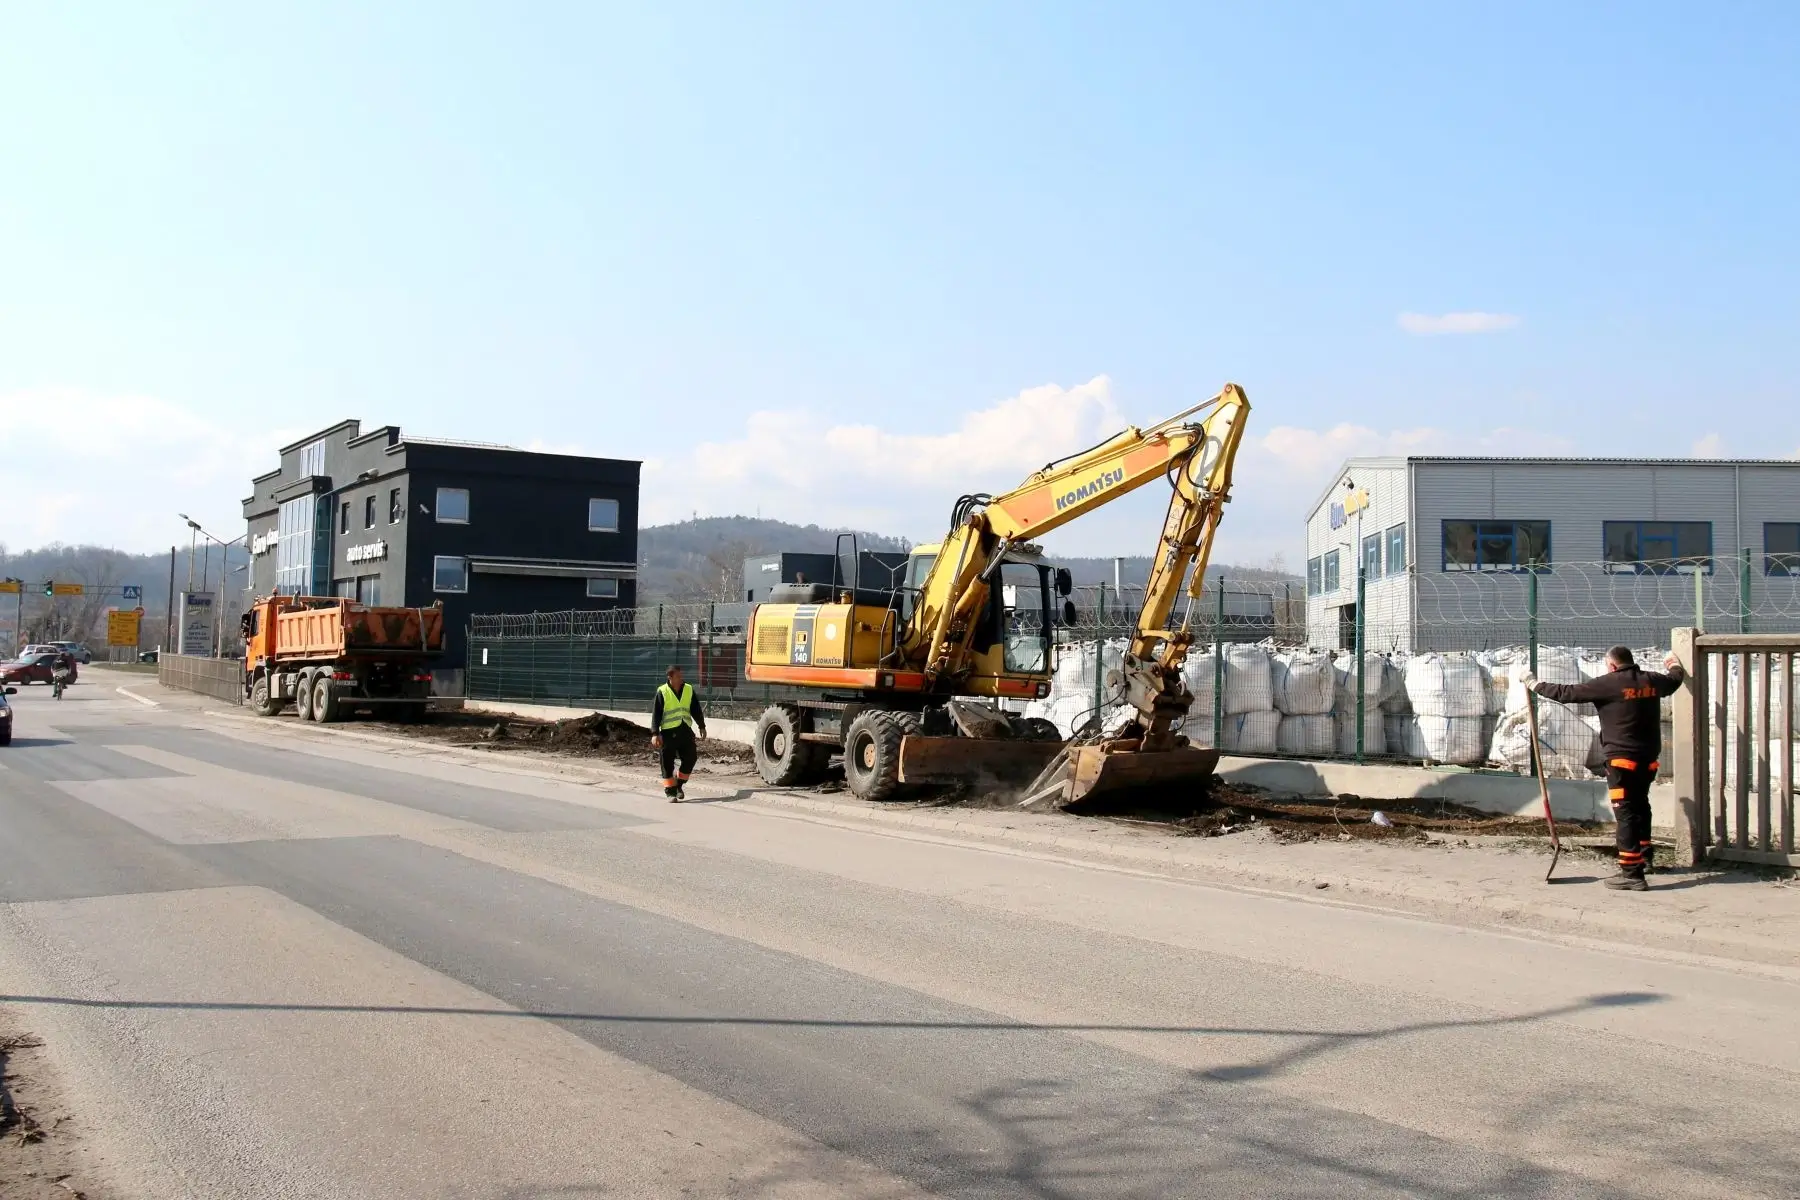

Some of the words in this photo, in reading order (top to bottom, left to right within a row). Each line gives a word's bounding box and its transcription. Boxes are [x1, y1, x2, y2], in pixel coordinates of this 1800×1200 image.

[1056, 467, 1124, 511] KOMATSU
[346, 544, 363, 562] auto
[362, 537, 384, 560] servis
[187, 594, 211, 606] Euro
[795, 644, 806, 652] PW
[794, 652, 808, 663] 140
